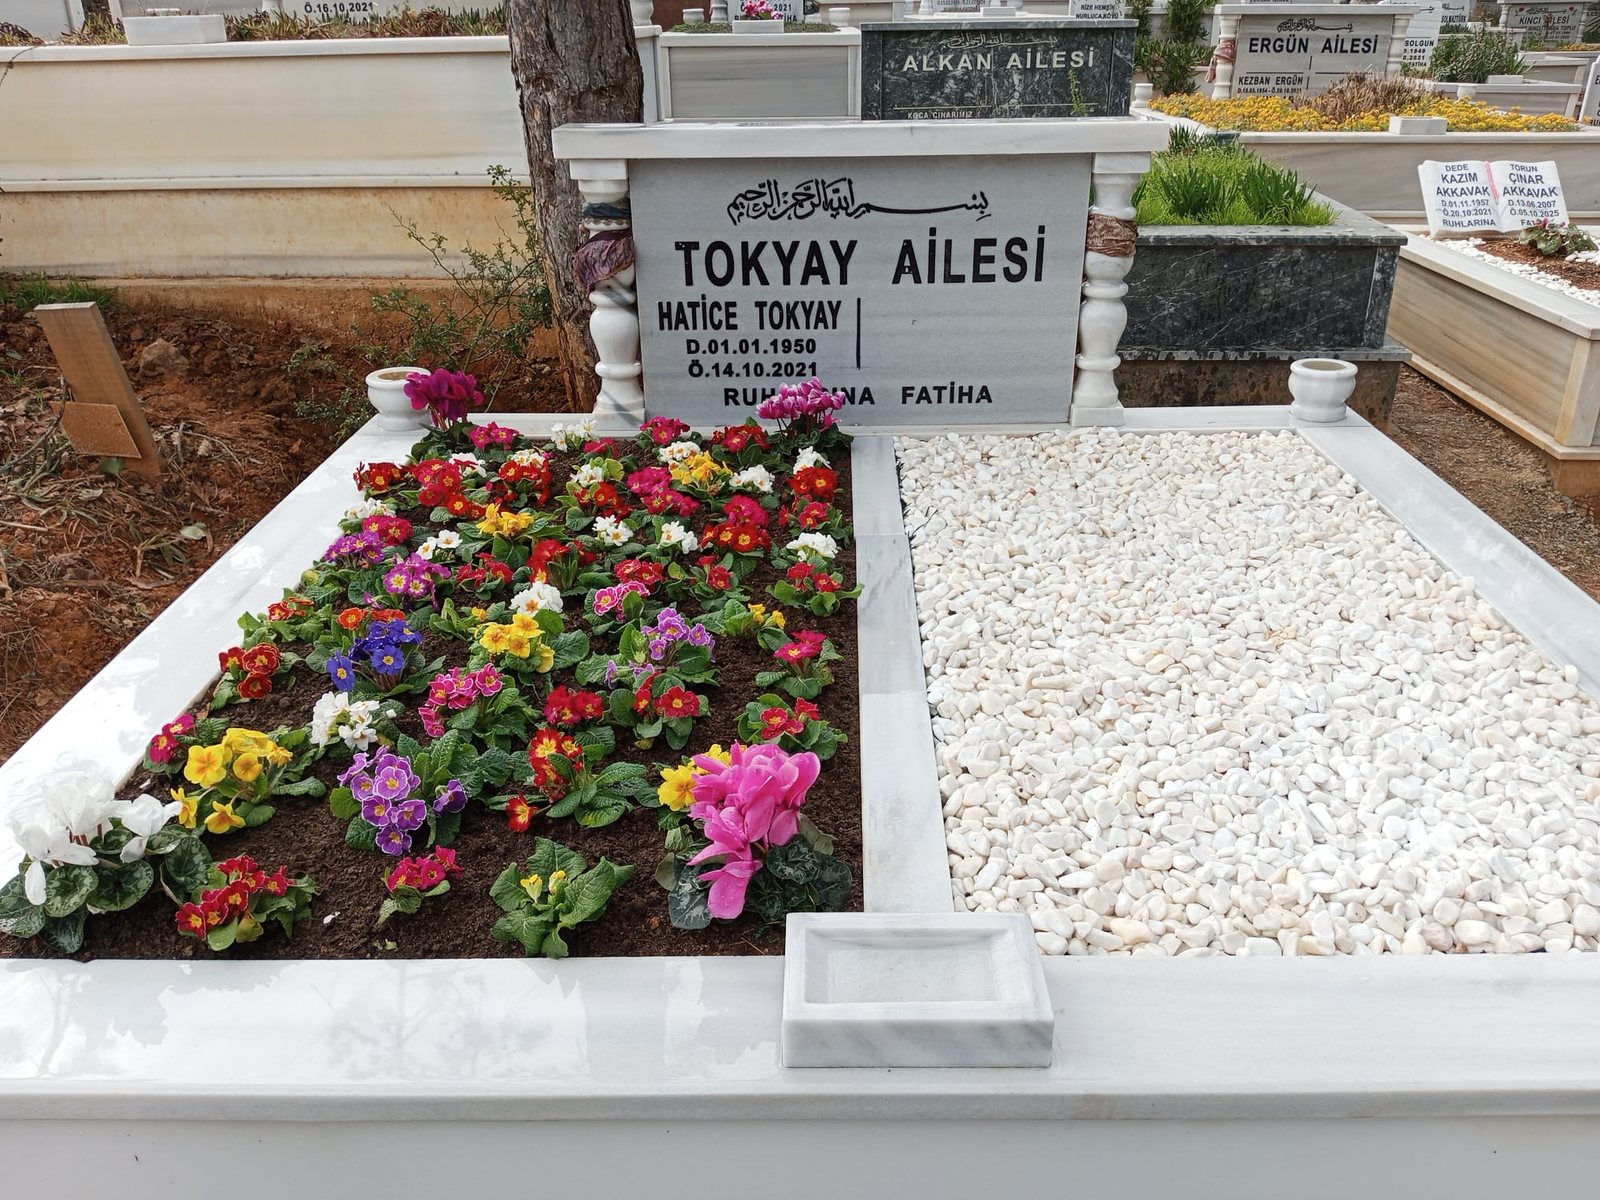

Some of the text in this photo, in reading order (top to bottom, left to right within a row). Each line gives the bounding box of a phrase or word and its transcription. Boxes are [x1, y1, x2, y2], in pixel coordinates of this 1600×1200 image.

[1249, 34, 1379, 53] ERGÜN AİLESİ
[902, 47, 1094, 72] ALKAN AİLESİ
[1238, 75, 1303, 85] KEZBAN ERGÜN
[1445, 164, 1469, 172] DEDE
[1510, 164, 1538, 172] TORUN
[1441, 173, 1478, 183] KAZIM
[1509, 173, 1544, 186] ÇINAR
[1436, 186, 1491, 197] AKKAVAK
[1502, 187, 1558, 198] AKKAVAK
[1441, 199, 1489, 207] D.01.11.1957
[1442, 208, 1492, 217] Ö.20.10.2021
[1442, 219, 1496, 228] RUHLARINA
[675, 225, 1046, 287] TOKYAY AİLESİ
[657, 294, 842, 331] HATİCE TOKYAY
[686, 338, 817, 355] D.01.01.1950
[688, 361, 818, 378] Ö.14.10.2021
[723, 381, 993, 406] RUHNA FATİHA
